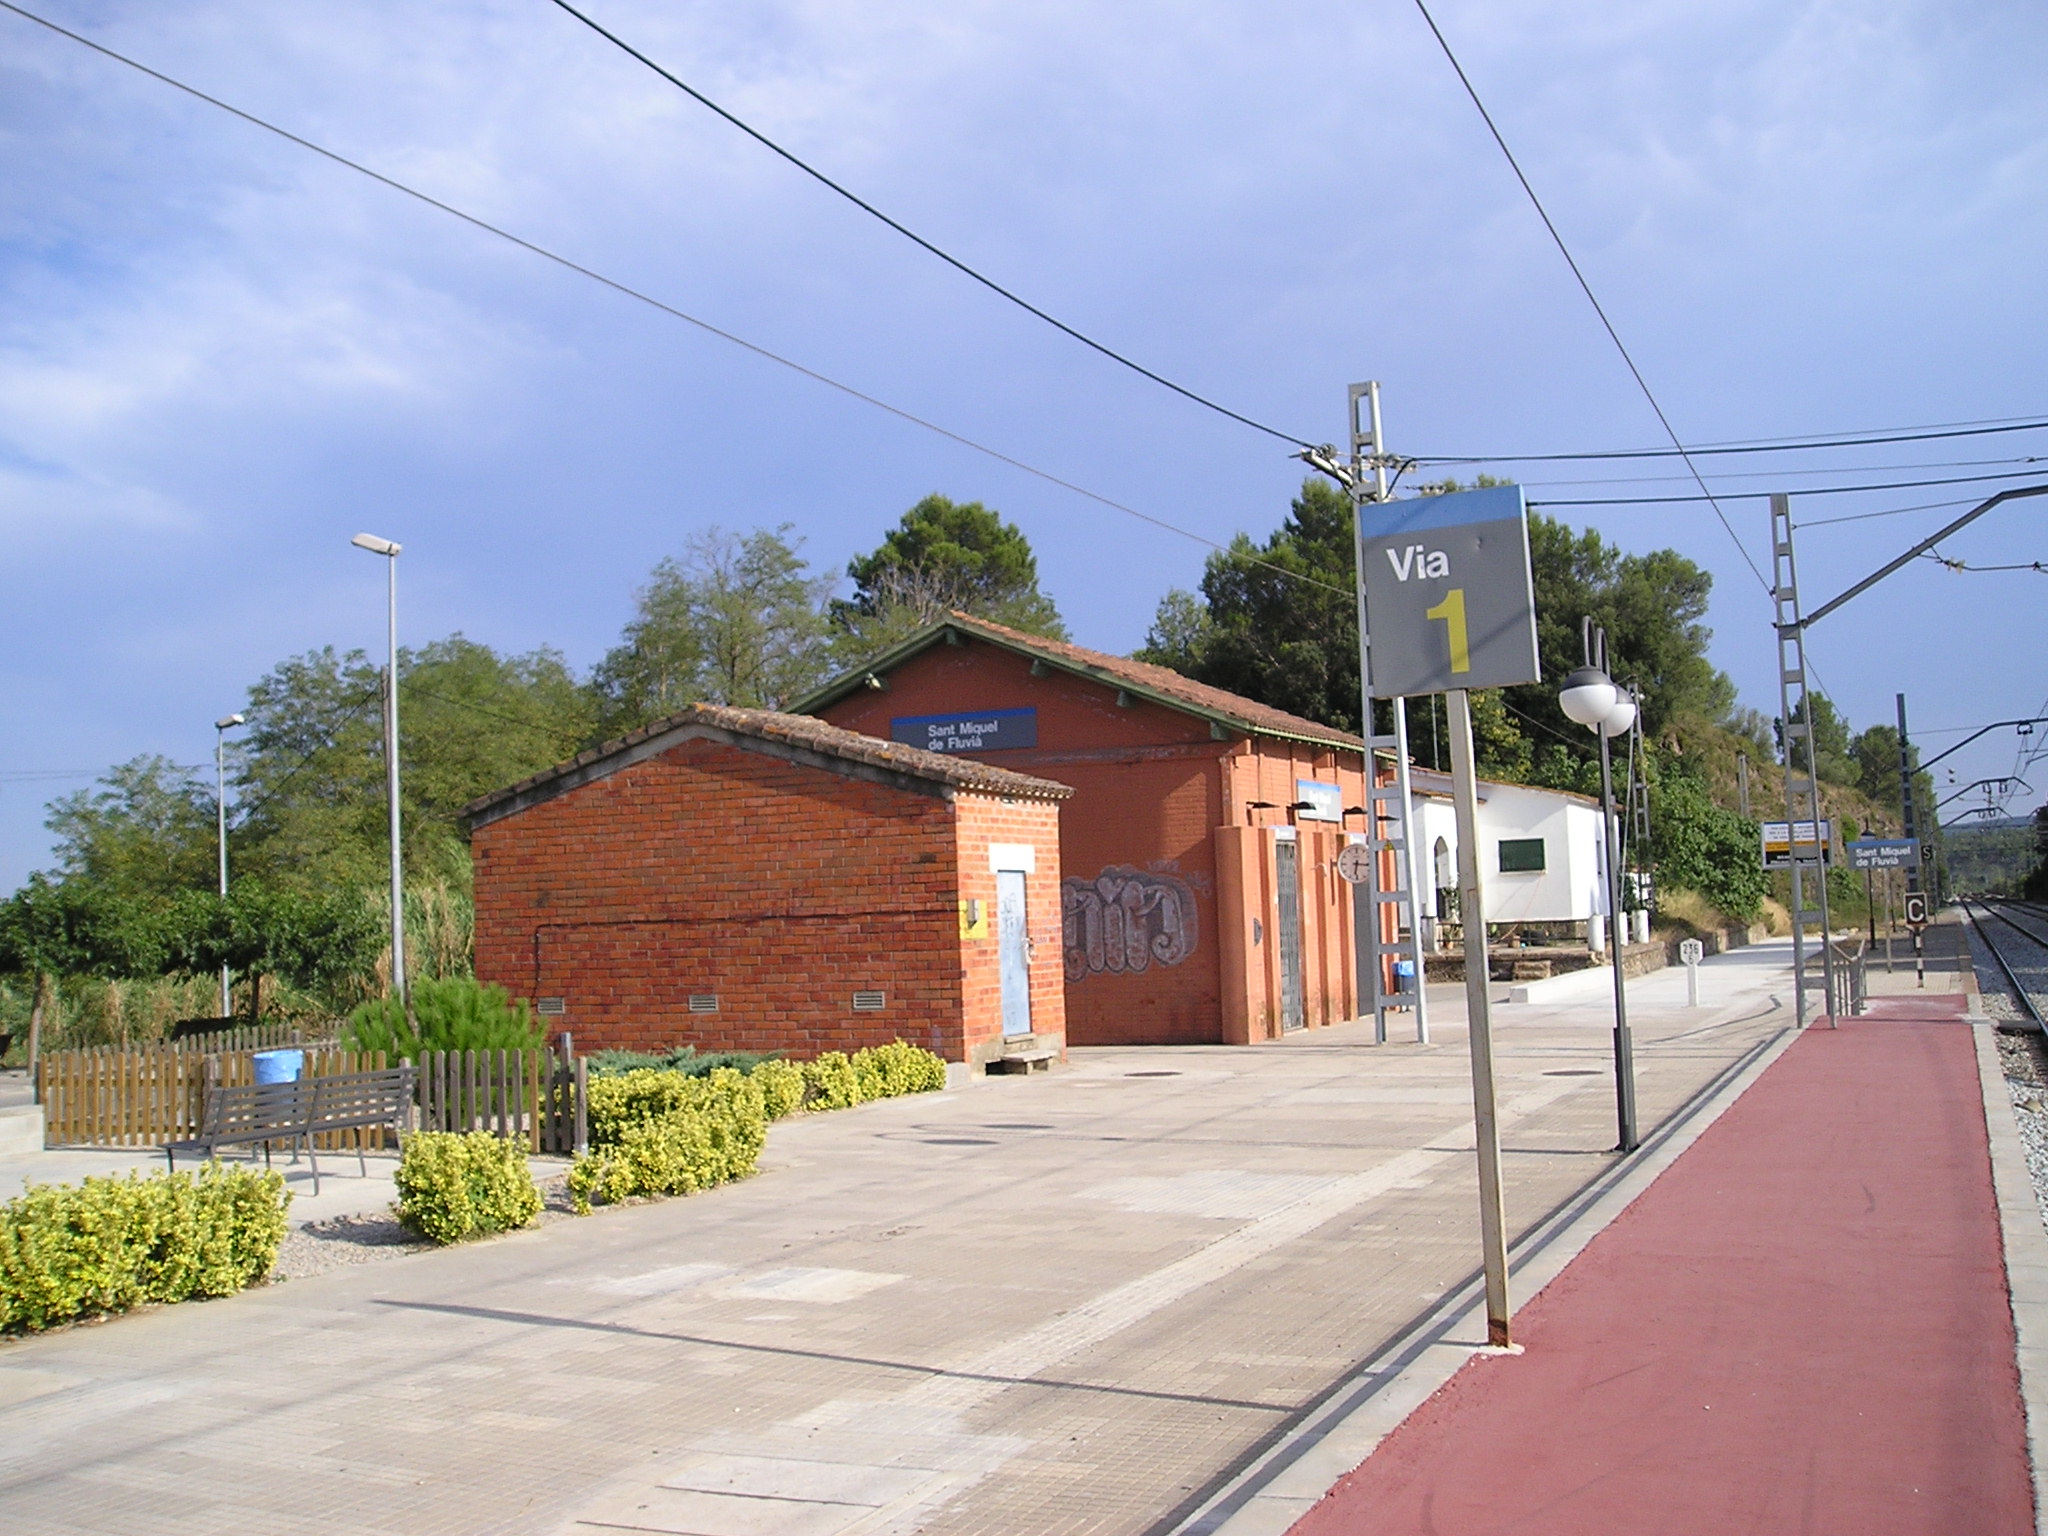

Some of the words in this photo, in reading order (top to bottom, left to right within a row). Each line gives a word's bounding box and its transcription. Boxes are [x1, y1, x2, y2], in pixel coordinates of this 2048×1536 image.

[1386, 544, 1450, 582] Via
[1426, 588, 1471, 674] 1
[928, 724, 955, 737] Sant
[959, 720, 998, 735] Miquel
[928, 739, 943, 751] de
[1855, 847, 1877, 857] Sant
[1880, 846, 1911, 856] Miquel
[1922, 846, 1931, 859] S
[1855, 858, 1869, 867] de
[1907, 899, 1925, 922] C
